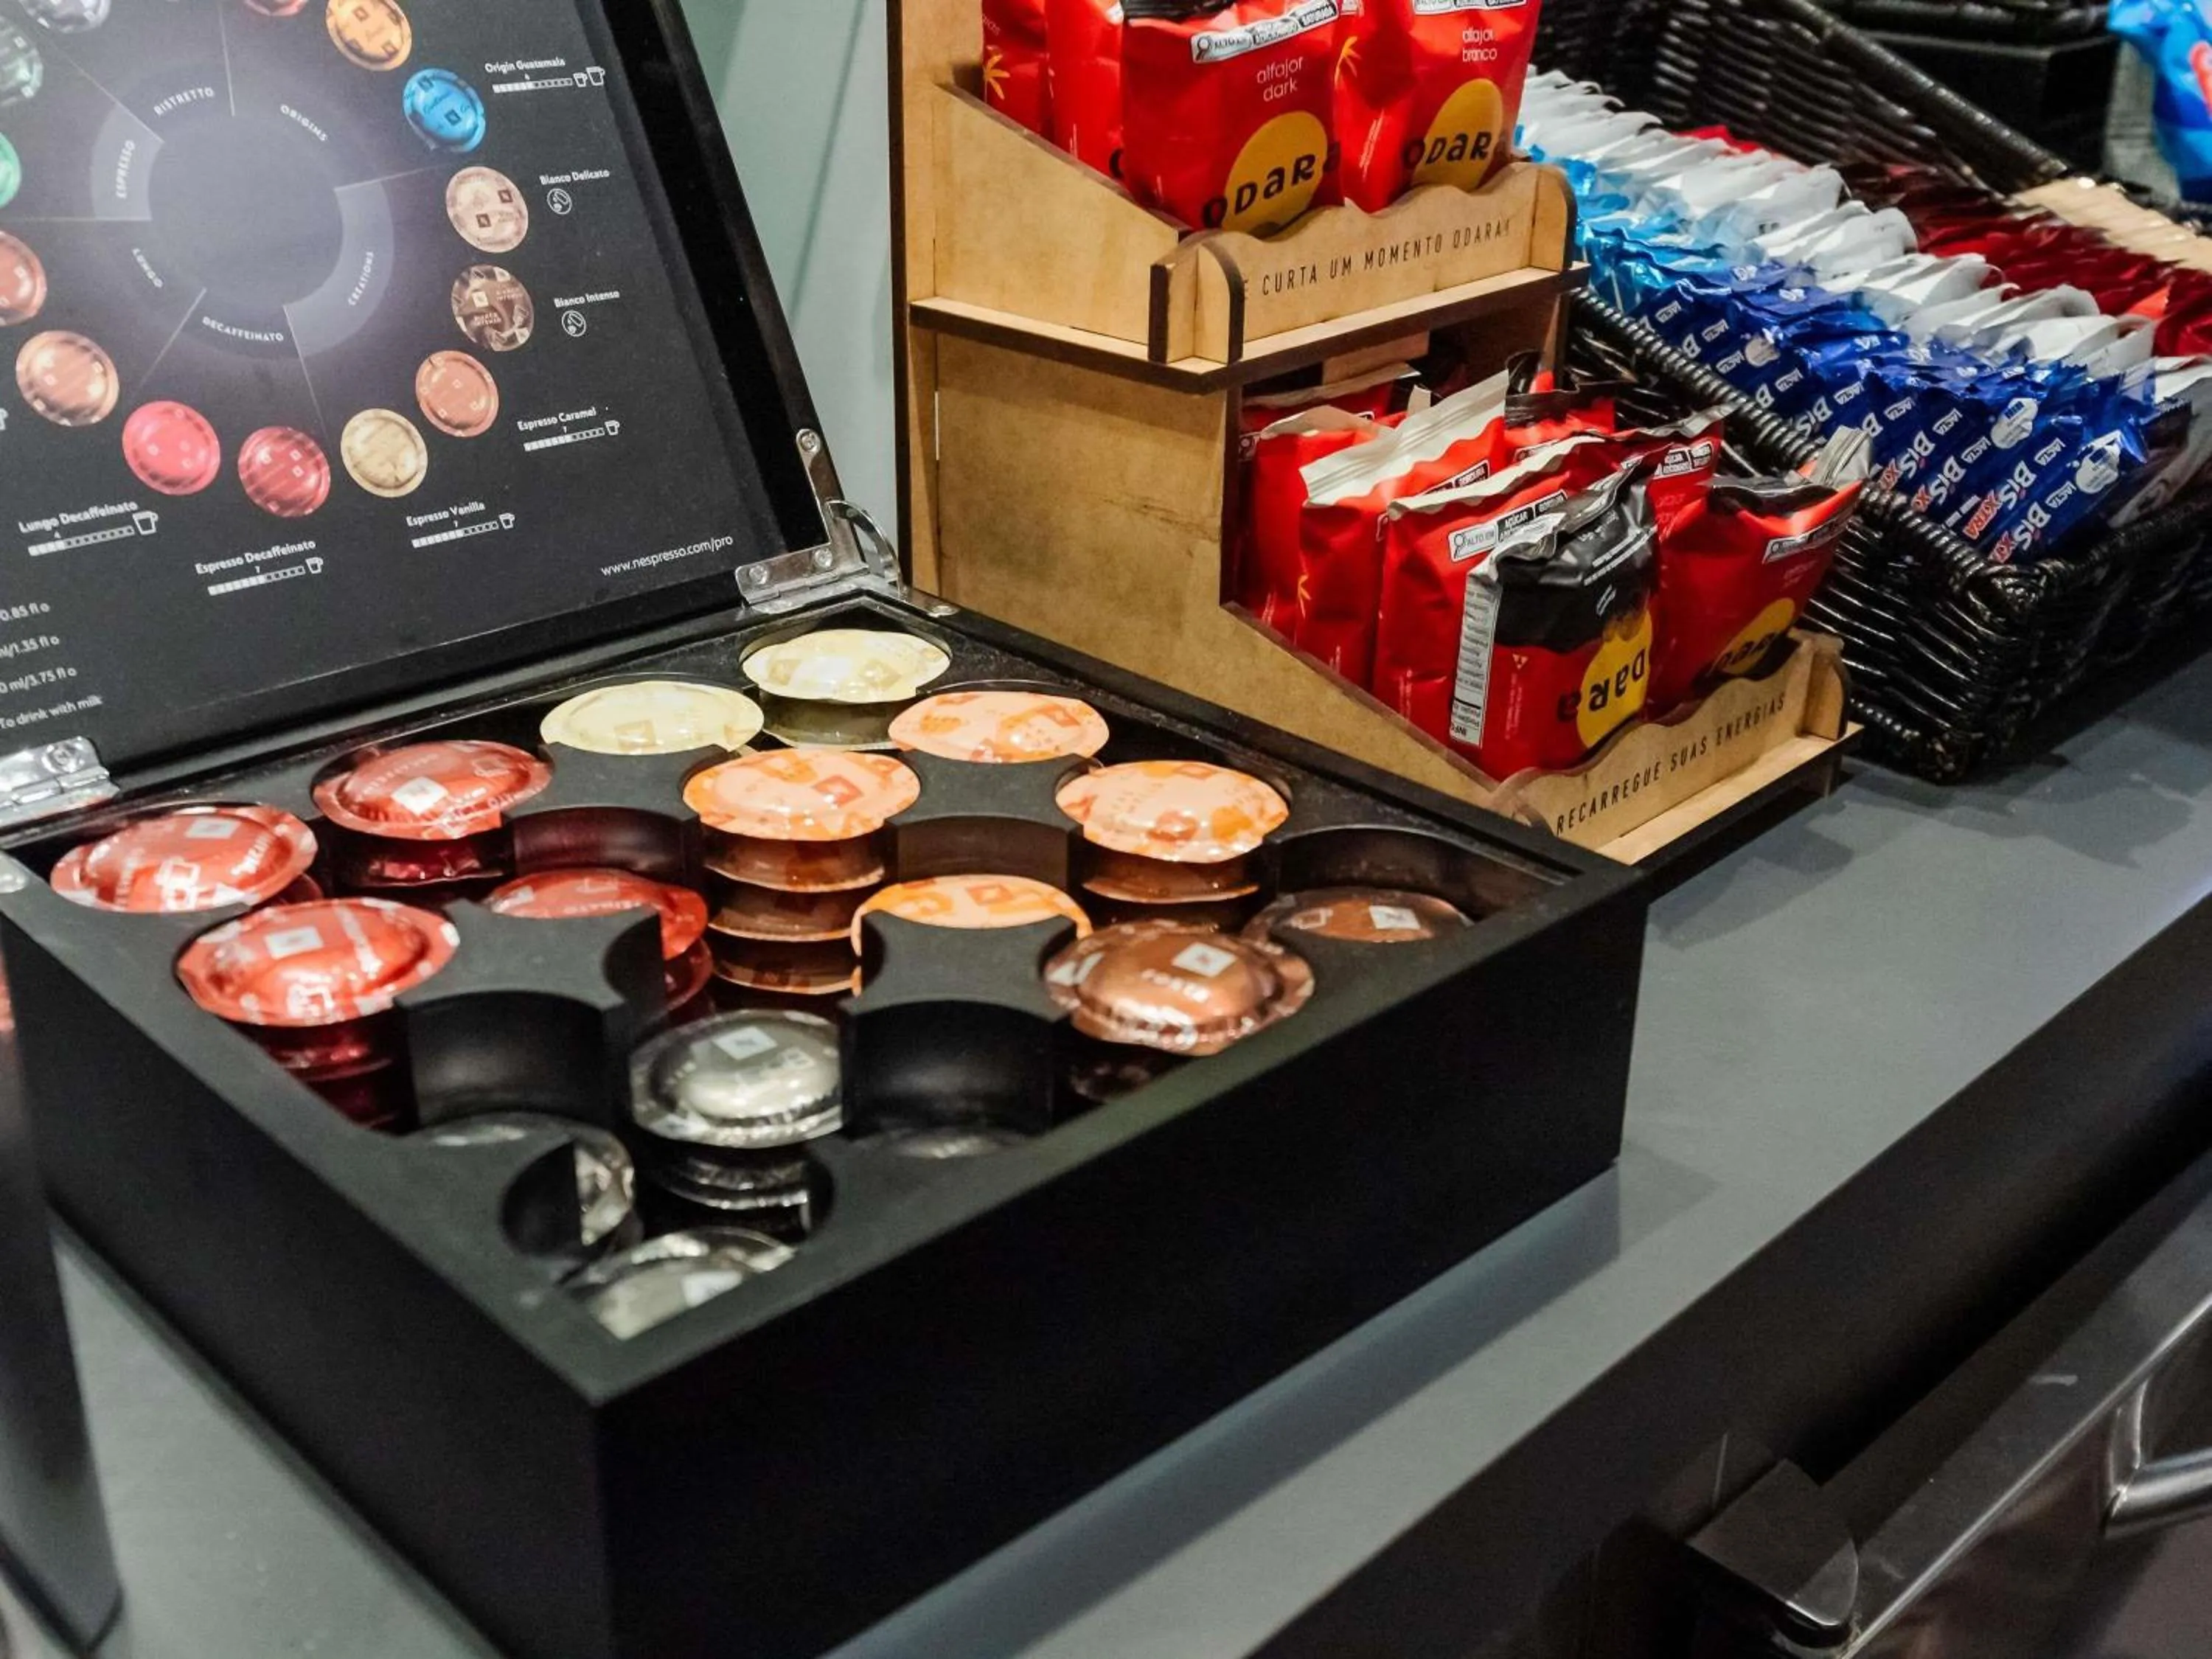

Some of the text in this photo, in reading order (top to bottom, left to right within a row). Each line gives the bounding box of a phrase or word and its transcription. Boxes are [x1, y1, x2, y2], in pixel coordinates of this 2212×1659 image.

[484, 61, 515, 74] Origin
[1256, 57, 1304, 84] alfajor
[153, 87, 215, 116] RISTRETTO
[1263, 77, 1298, 102] dark
[280, 104, 328, 142] ORIGINS
[539, 168, 610, 186] Bianco Delicato
[347, 251, 374, 306] CREATIONS
[1262, 263, 1318, 296] CURTA
[1329, 255, 1352, 279] UM
[1364, 233, 1443, 271] MOMENTO
[554, 289, 620, 307] Bianco Intenso
[202, 316, 284, 342] DECAFFEINATO
[517, 406, 597, 431] Espresso Caramel
[1899, 430, 1935, 479] BIS
[1930, 455, 1966, 505] BIS
[1997, 460, 2037, 510] BIS
[18, 501, 139, 533] Lungo Decaffeinato
[406, 501, 485, 526] Espresso Vanilla
[2013, 501, 2051, 551] BIS
[195, 540, 316, 575] Espresso Decaffeinato
[601, 535, 734, 576] www.nespresso.com/pro
[15, 708, 49, 726] drink
[49, 701, 77, 717] with
[1557, 691, 1786, 837] RECARREGUE SUAS ENERGIAS
